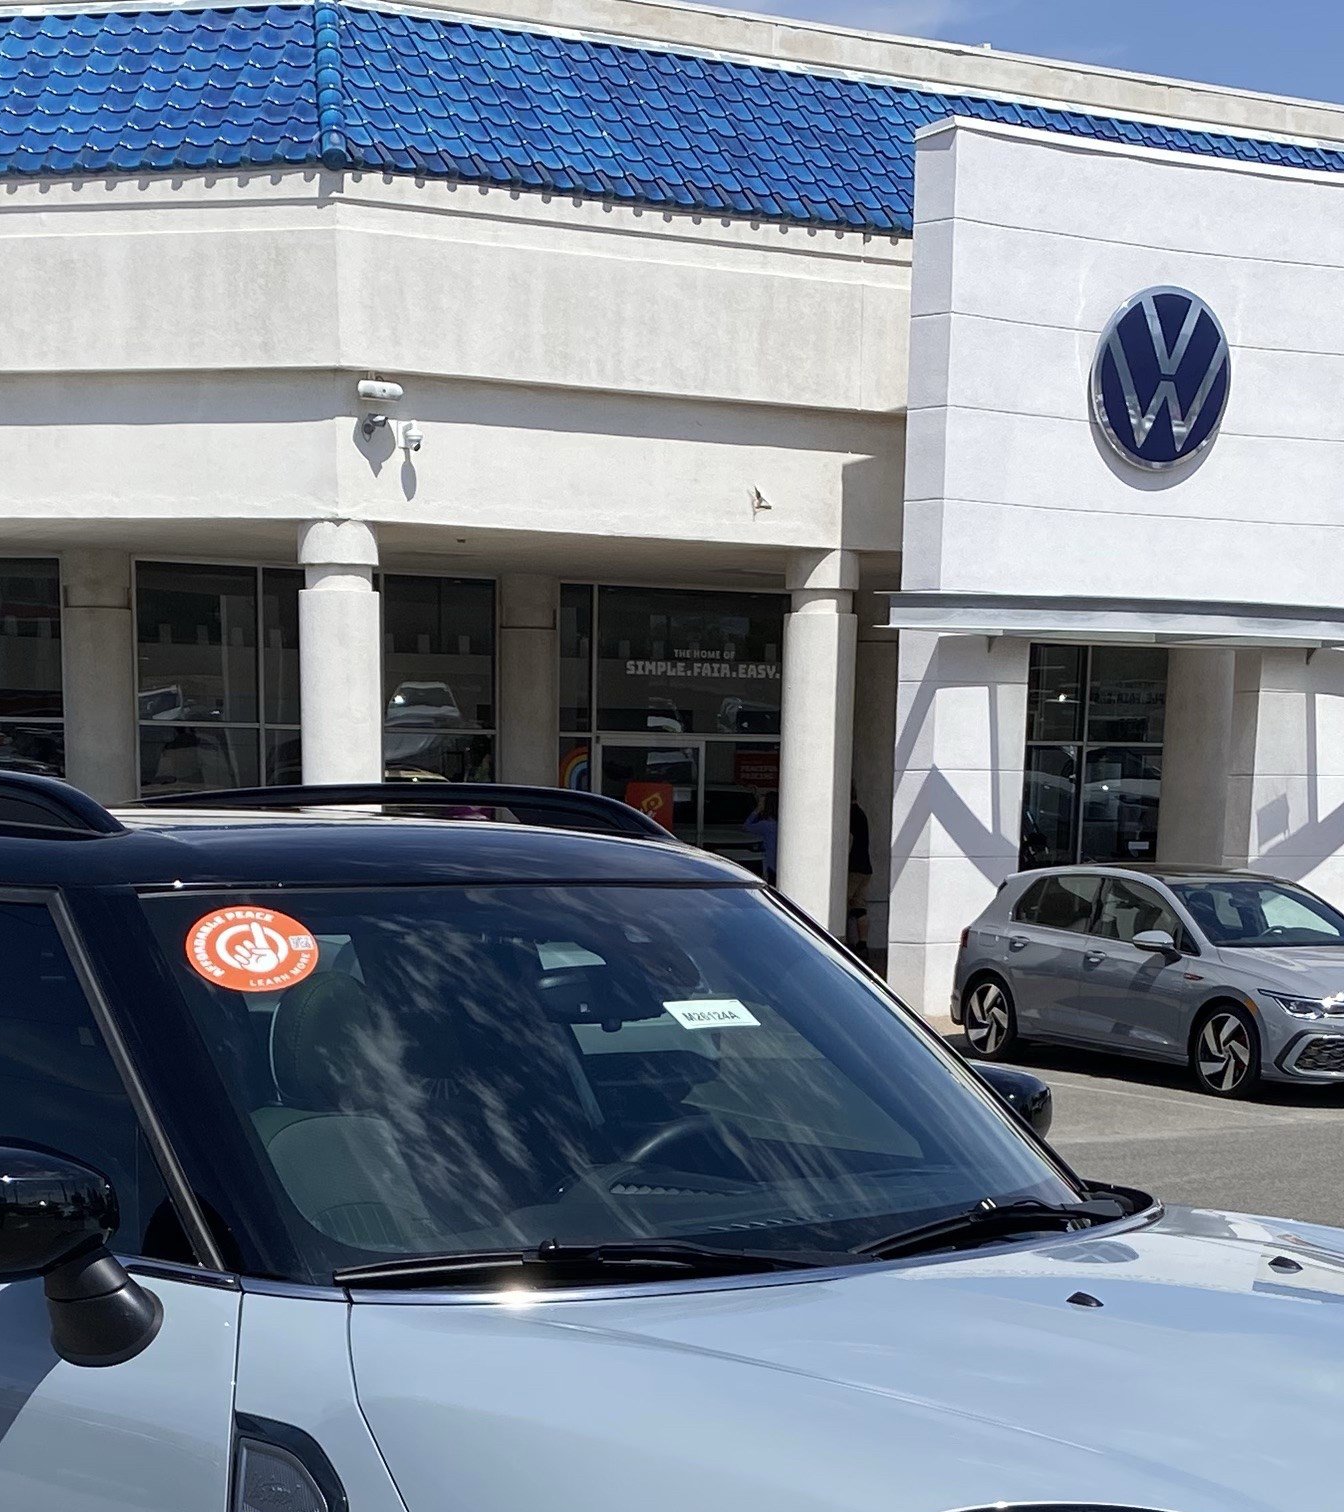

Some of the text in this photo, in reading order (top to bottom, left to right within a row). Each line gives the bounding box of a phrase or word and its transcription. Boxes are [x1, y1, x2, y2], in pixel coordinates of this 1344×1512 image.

[673, 649, 736, 660] THE HOME OF
[193, 910, 275, 978] AFFORDABLE PEACE
[249, 952, 312, 987] LEARN MORE
